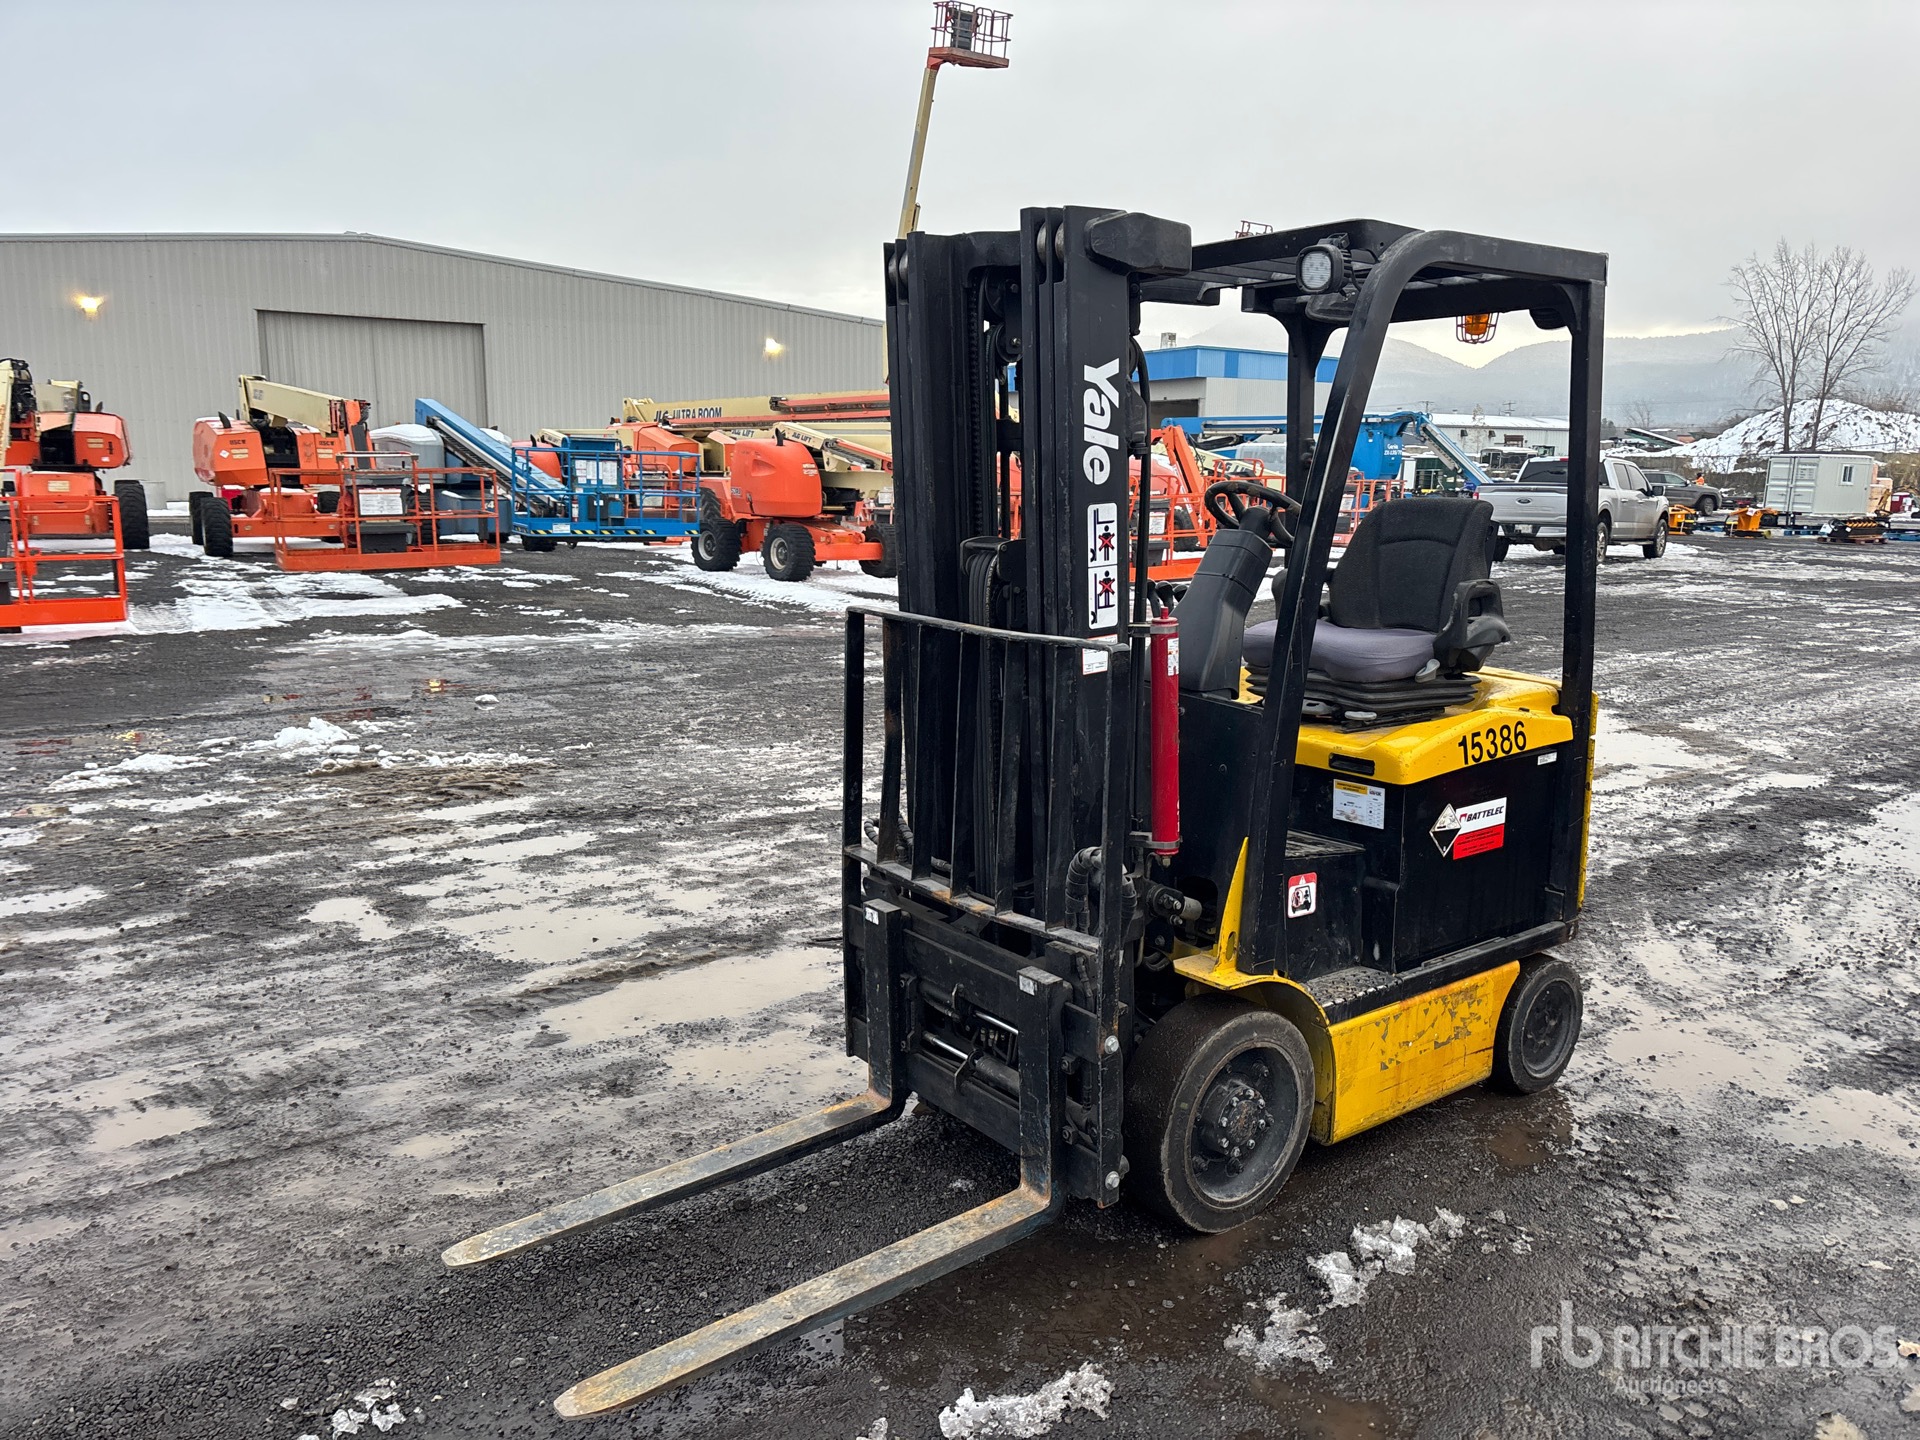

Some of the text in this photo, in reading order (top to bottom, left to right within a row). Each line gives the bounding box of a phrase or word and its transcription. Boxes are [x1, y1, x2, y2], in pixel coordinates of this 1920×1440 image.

[698, 406, 722, 418] BOOM
[1083, 358, 1119, 485] Yale
[801, 434, 812, 444] LIFT
[1458, 720, 1527, 765] 15386
[1466, 805, 1504, 822] BATTELEC
